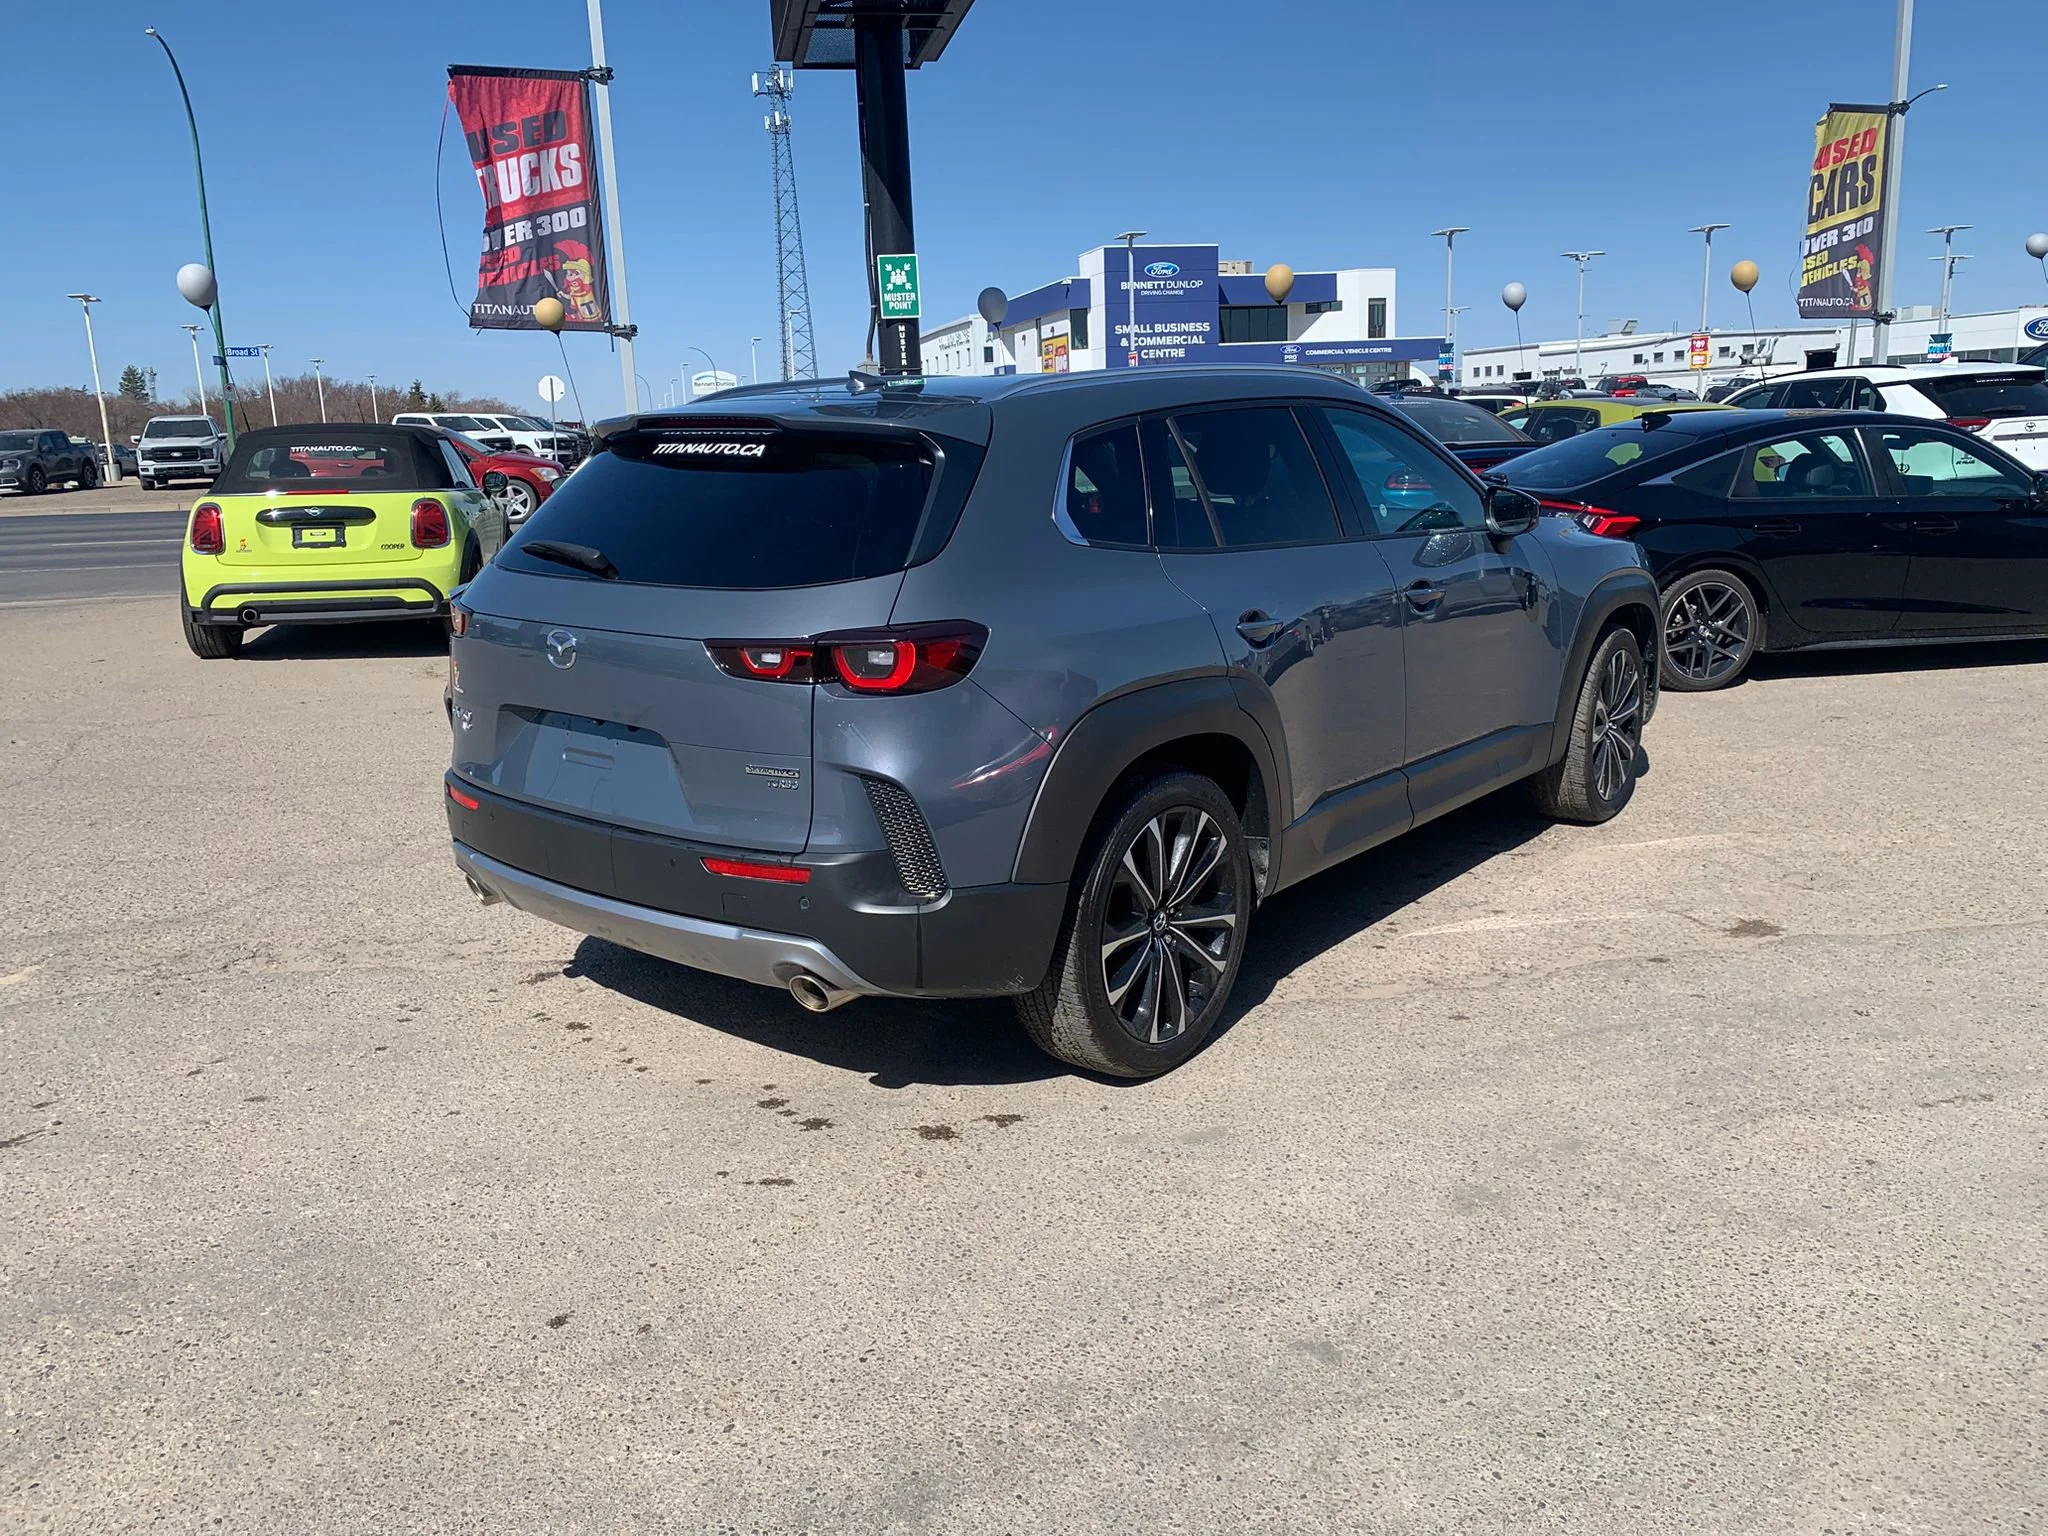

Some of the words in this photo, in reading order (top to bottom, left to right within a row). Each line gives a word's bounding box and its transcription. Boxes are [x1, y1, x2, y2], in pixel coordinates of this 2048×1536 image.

[465, 110, 568, 163] USED
[1814, 127, 1877, 171] USED
[1807, 154, 1877, 222] CARS
[536, 206, 587, 237] 300
[1166, 280, 1204, 289] DUNLOP
[883, 292, 916, 302] MUSTER
[889, 301, 912, 310] POINT
[1114, 324, 1153, 335] SMALL
[1154, 322, 1211, 333] BUSINESS
[898, 324, 908, 366] MUSTER
[1140, 348, 1186, 359] CENTRE
[652, 442, 766, 457] TITANAUTO.CA
